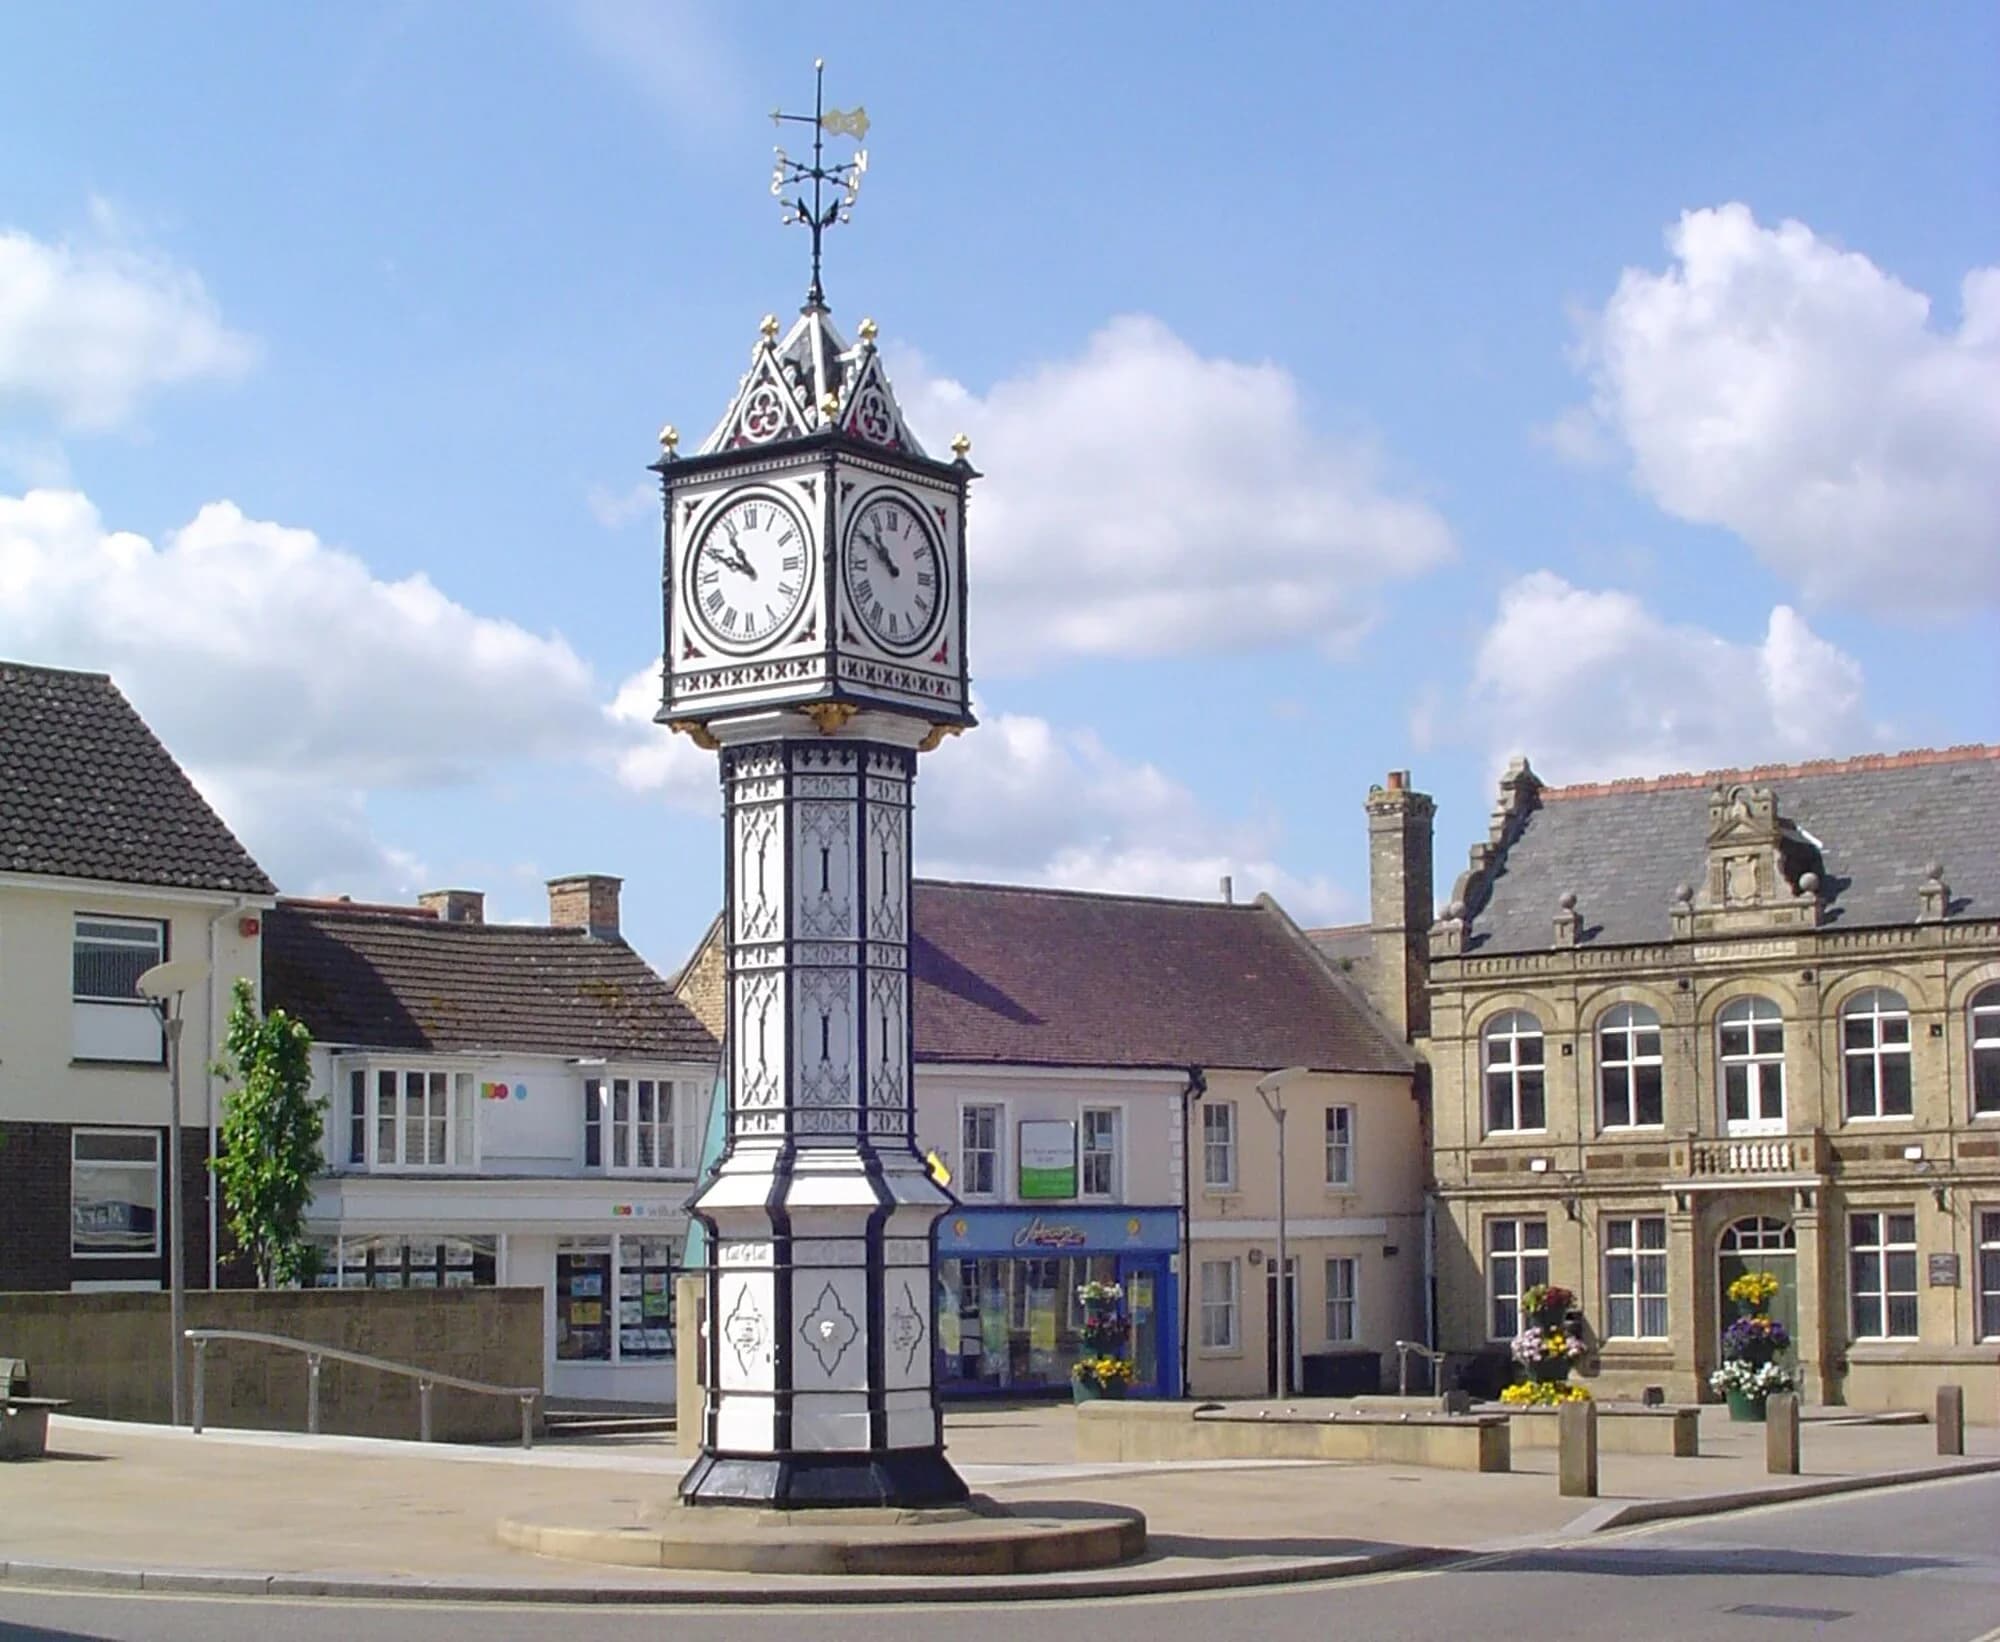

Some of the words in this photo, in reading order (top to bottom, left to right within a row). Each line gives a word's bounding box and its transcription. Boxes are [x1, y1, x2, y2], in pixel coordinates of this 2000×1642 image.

[743, 508, 757, 531] XII
[777, 529, 794, 547] II
[782, 556, 799, 571] III
[917, 572, 931, 586] III
[1751, 941, 1795, 957] HALL
